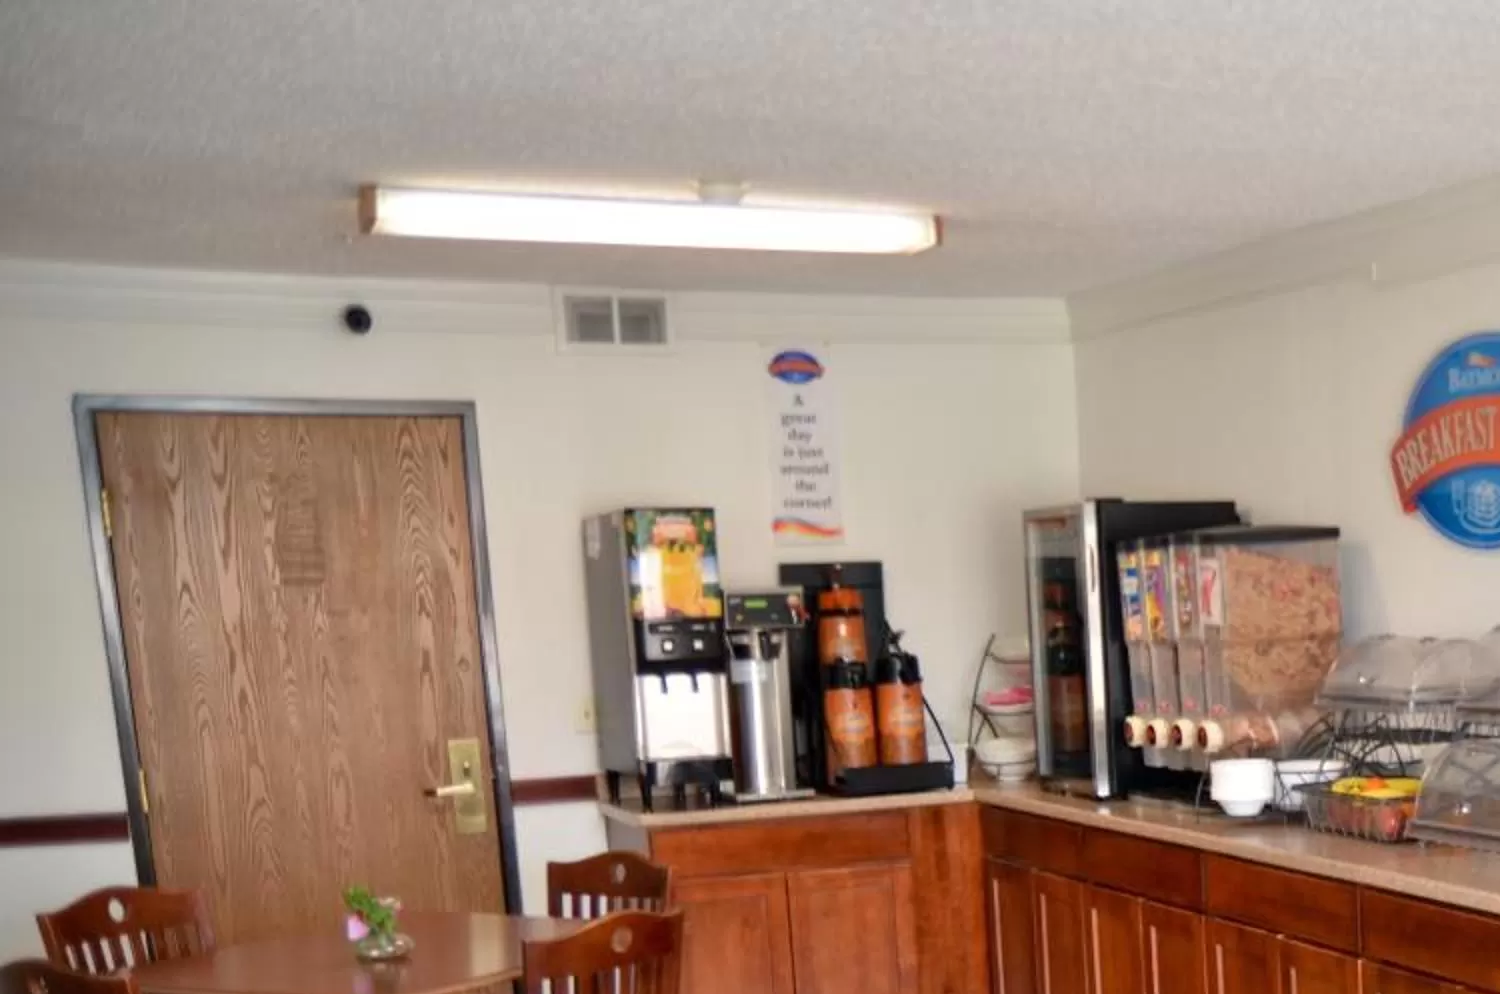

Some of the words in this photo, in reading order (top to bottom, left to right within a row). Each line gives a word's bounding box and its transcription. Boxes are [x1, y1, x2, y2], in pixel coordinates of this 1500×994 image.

[787, 428, 813, 444] day
[1396, 405, 1497, 488] BREAKFAST
[780, 462, 829, 475] around
